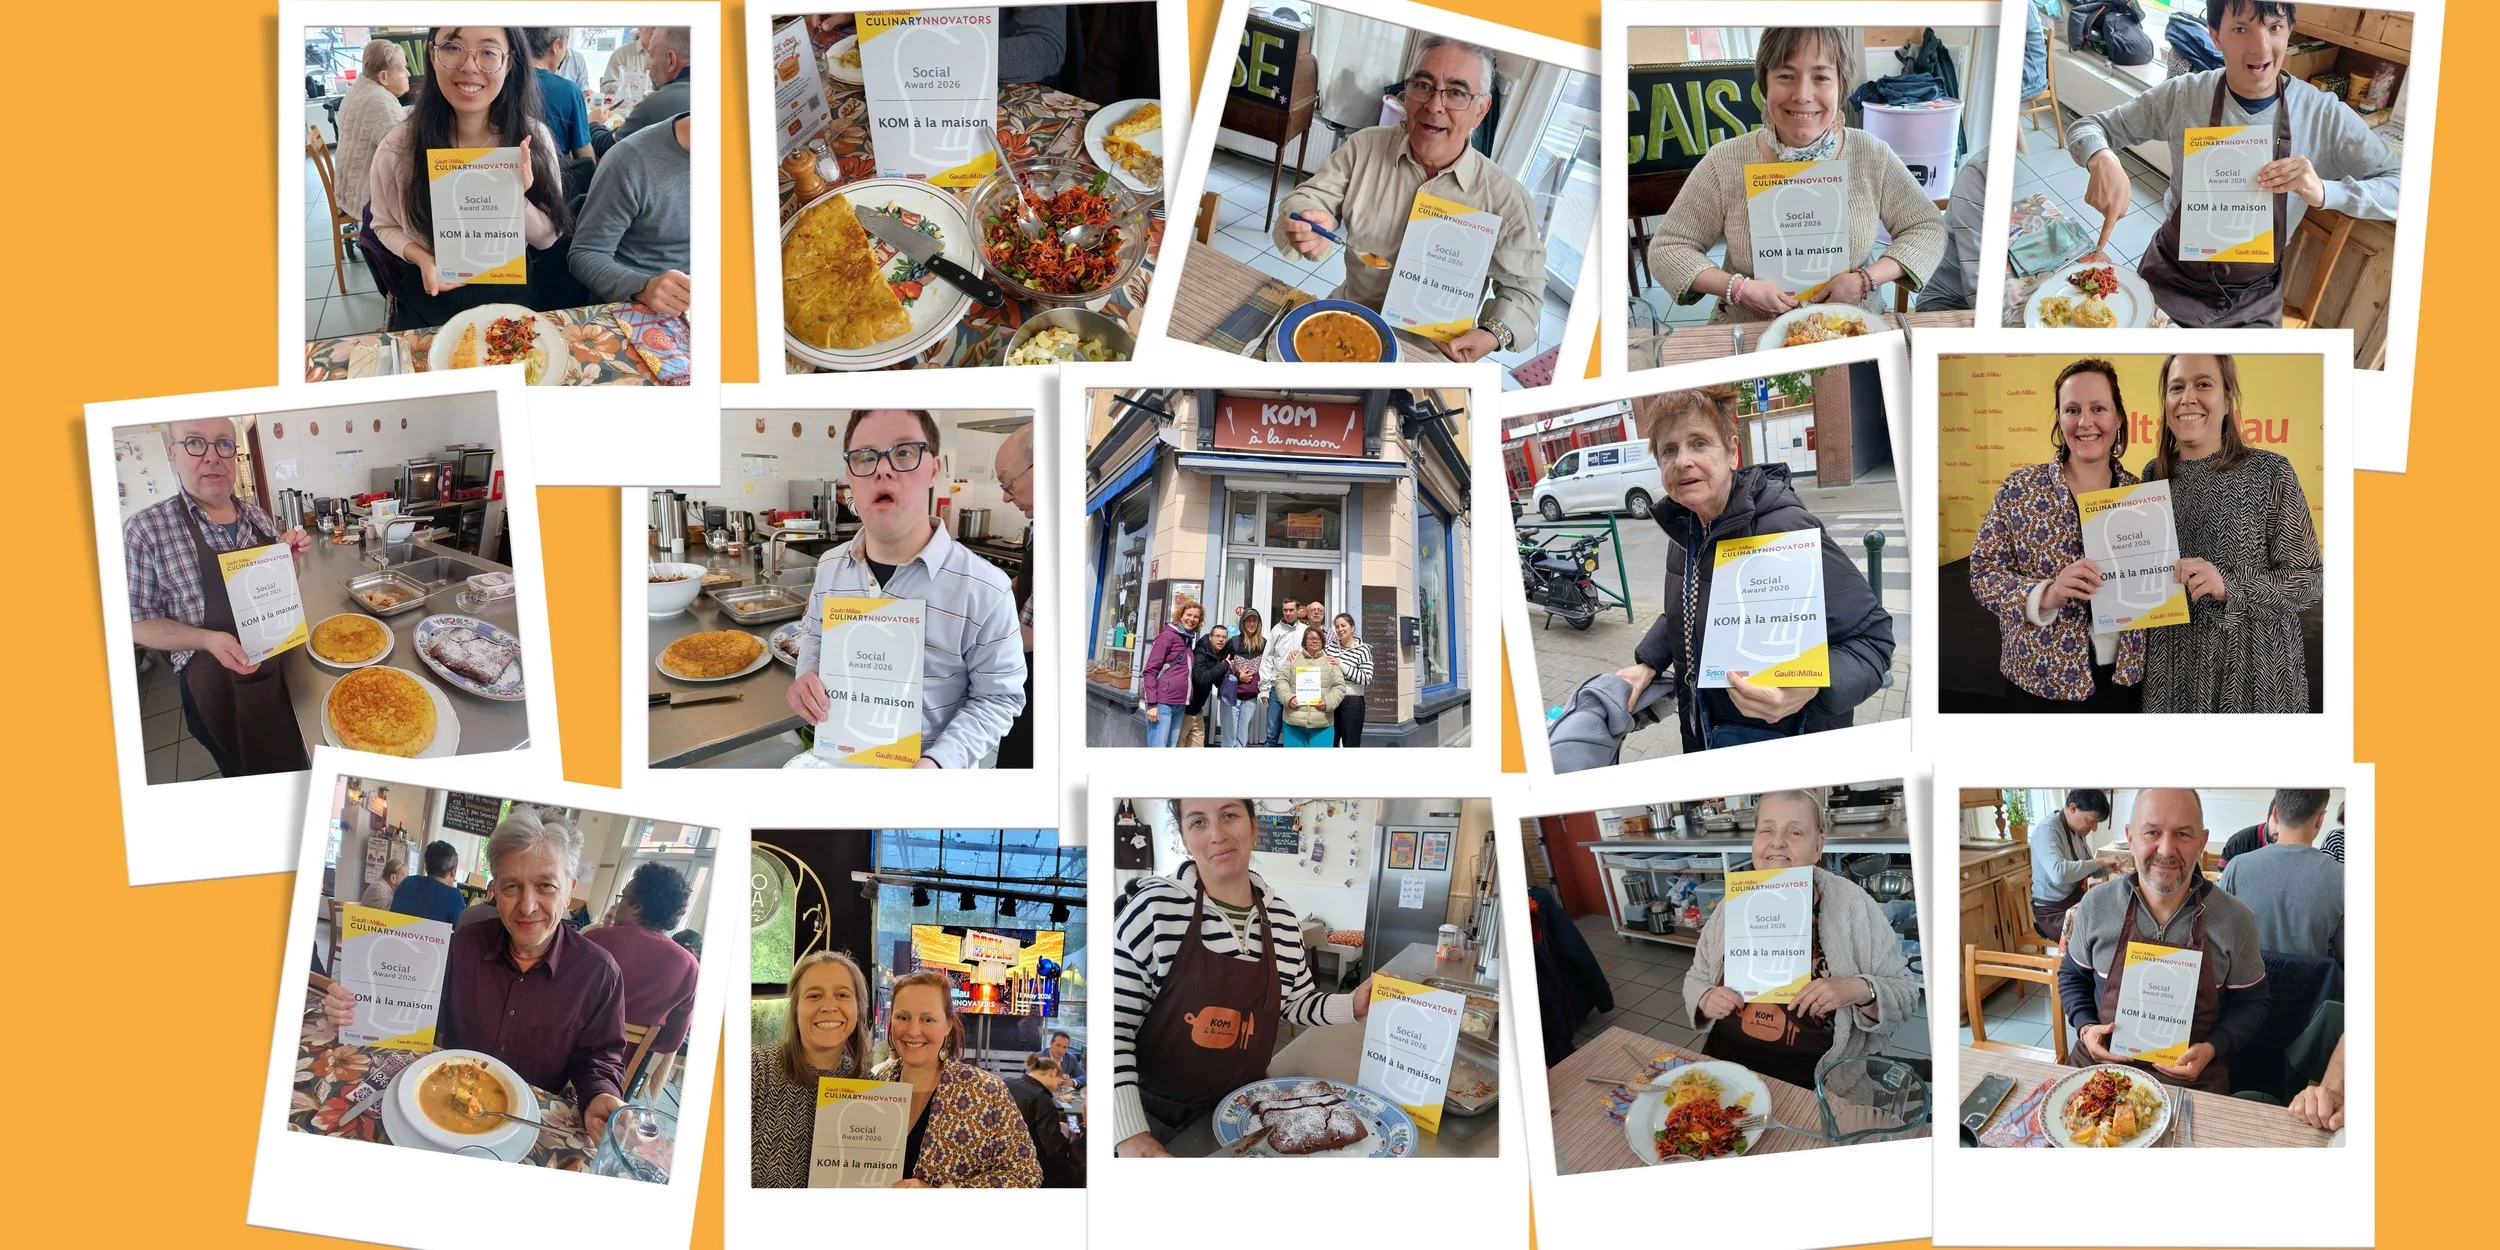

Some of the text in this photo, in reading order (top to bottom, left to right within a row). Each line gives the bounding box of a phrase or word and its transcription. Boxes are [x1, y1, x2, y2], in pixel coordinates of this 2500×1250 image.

[913, 67, 950, 77] Social
[879, 118, 988, 128] KOM à la maison
[1786, 211, 1813, 220] Social
[1435, 244, 1459, 258] Social
[1759, 249, 1782, 258] KOM
[1786, 248, 1792, 256] à
[1808, 247, 1842, 255] maison
[1427, 252, 1463, 267] Award 2026
[1399, 270, 1474, 299] KOM à la maison
[1758, 378, 1765, 396] P
[1262, 404, 1316, 427] KOM
[1249, 428, 1340, 449] à la maison
[2117, 531, 2143, 542] Social
[2100, 564, 2175, 581] OM à la maison
[1750, 576, 1781, 586] Social
[256, 583, 276, 593] Social
[242, 617, 259, 627] KOM
[276, 604, 298, 615] maison
[1714, 613, 1817, 626] KOM à la maison
[856, 651, 885, 661] Social
[874, 663, 892, 671] 2026
[1706, 669, 1725, 677] Sysco
[824, 689, 914, 708] KOM à la maison
[1756, 914, 1780, 922] Social
[1753, 948, 1758, 956] à
[381, 962, 410, 973] Social
[373, 970, 396, 979] Award
[2149, 983, 2170, 991] Social
[351, 993, 372, 1002] OM
[397, 1000, 432, 1010] maison
[1755, 1011, 1773, 1020] KOM
[2122, 1008, 2139, 1017] KOM
[2158, 1015, 2186, 1026] maison
[1210, 1018, 1231, 1028] KOM
[1397, 1026, 1421, 1040] Social
[1390, 1033, 1427, 1050] Award 2026
[1367, 1050, 1441, 1085] KOM à la maison
[817, 1159, 840, 1167] KOM
[864, 1161, 898, 1169] maison
